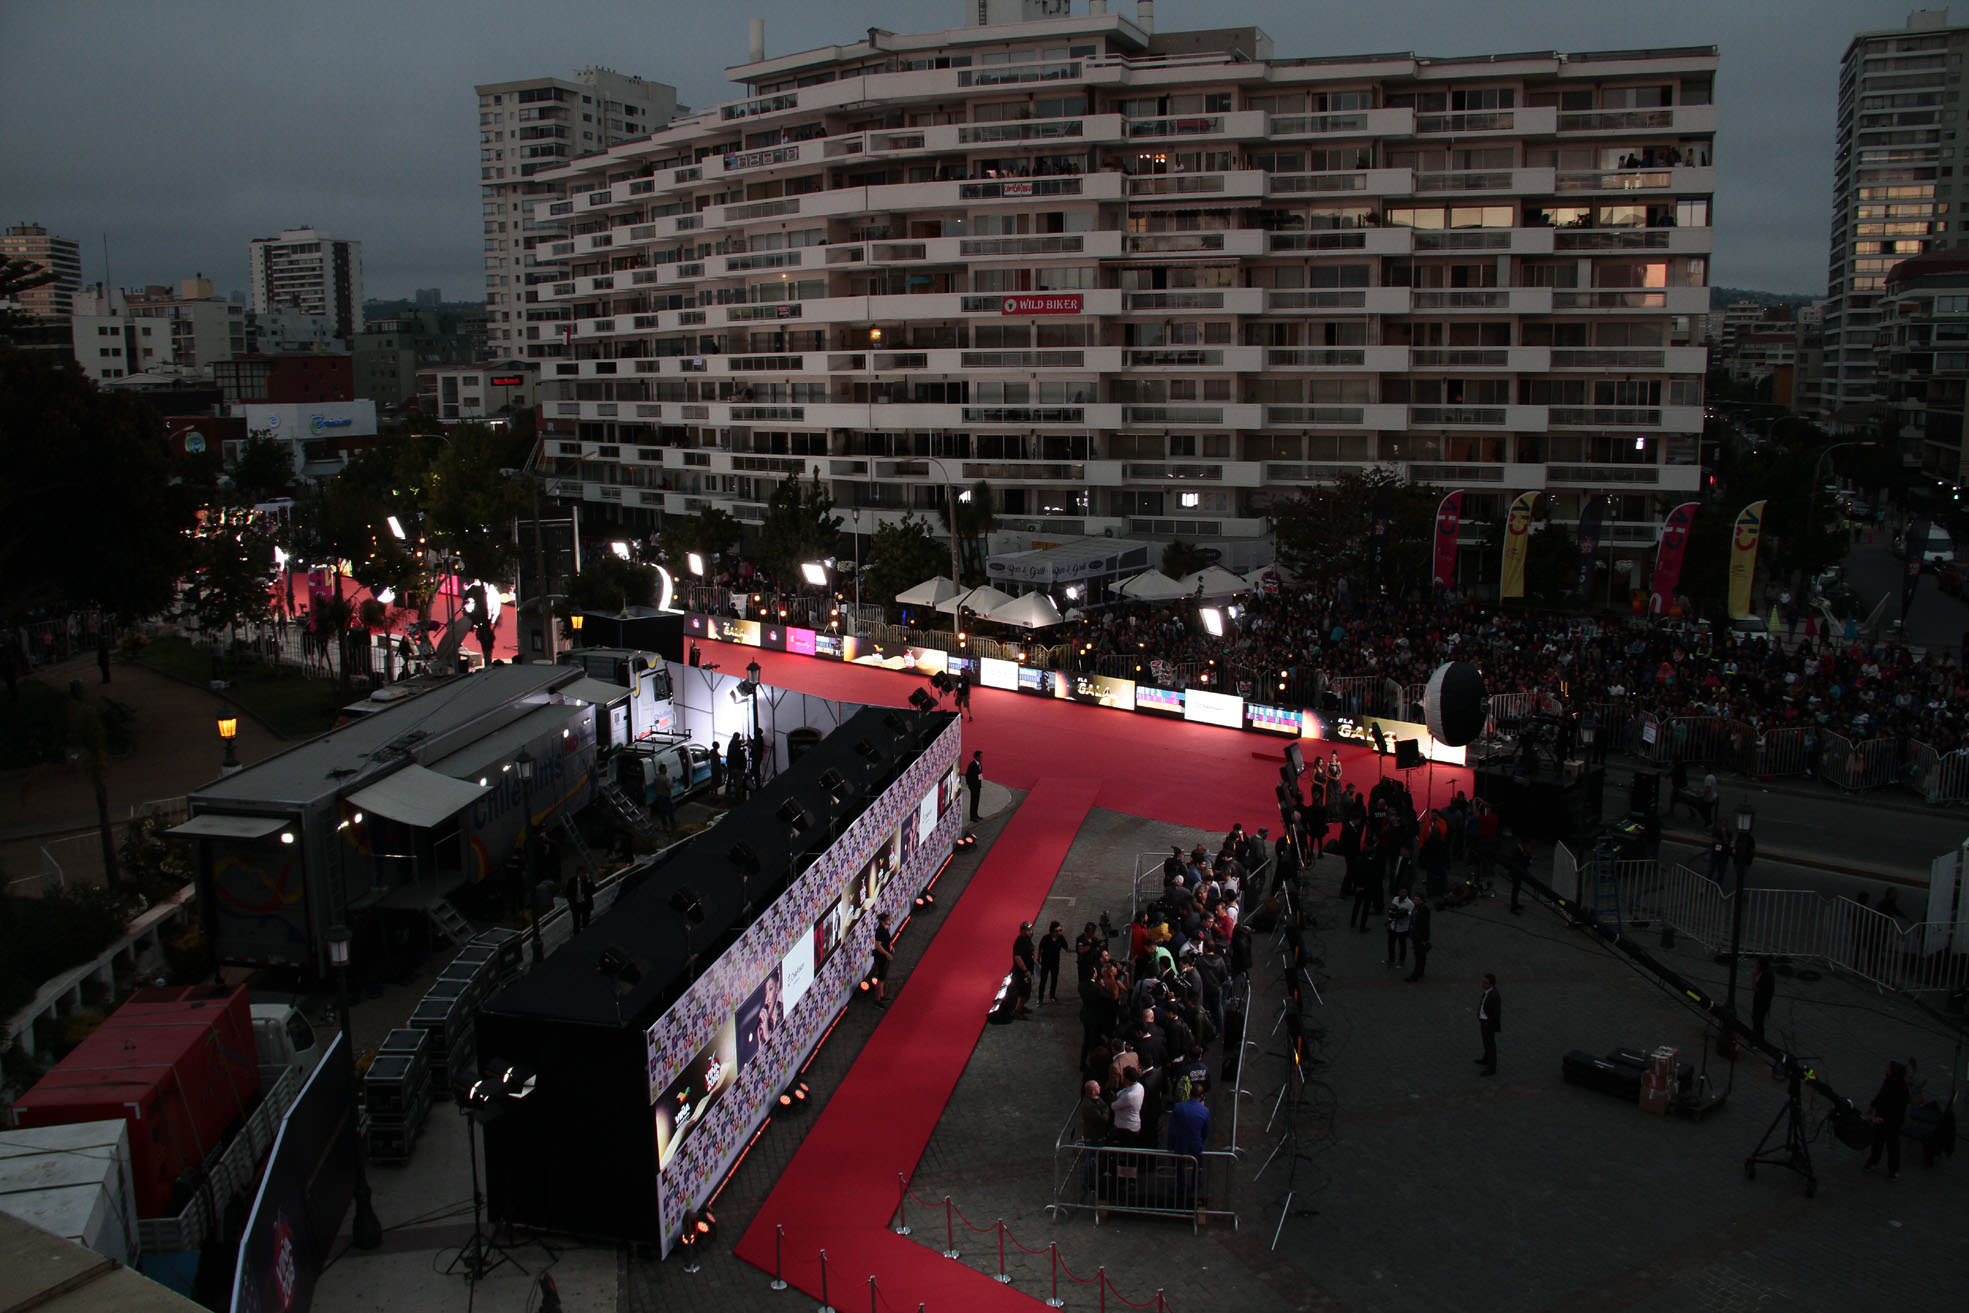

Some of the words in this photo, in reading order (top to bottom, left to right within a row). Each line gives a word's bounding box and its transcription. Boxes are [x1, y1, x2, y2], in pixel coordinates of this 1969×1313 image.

[1020, 298, 1044, 310] WILD
[1046, 299, 1078, 310] BIKER
[1077, 682, 1112, 698] GALA
